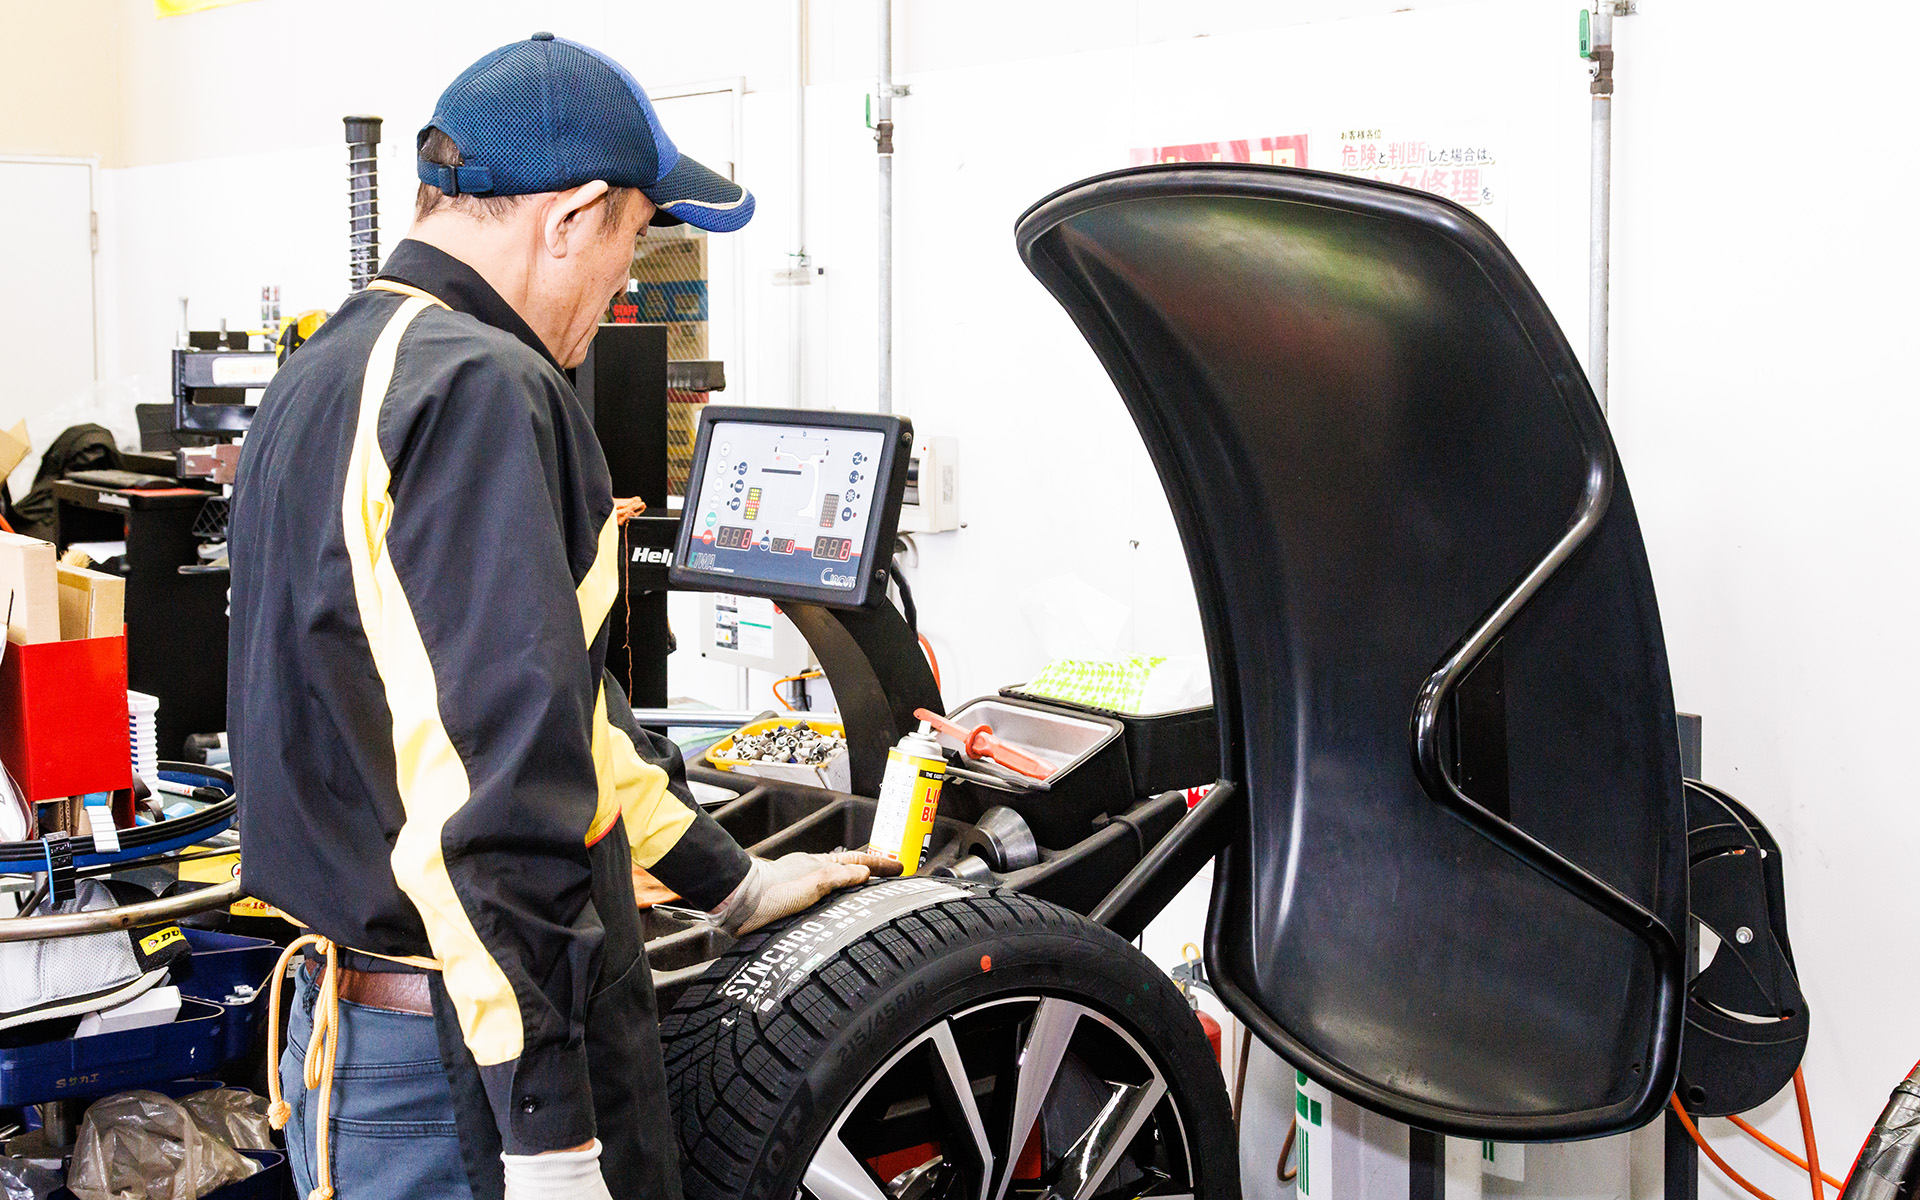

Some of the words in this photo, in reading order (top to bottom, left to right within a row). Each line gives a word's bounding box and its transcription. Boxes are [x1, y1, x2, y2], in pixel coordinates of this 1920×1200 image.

[1341, 129, 1382, 140] お客様各位
[1342, 141, 1494, 167] 危険と判断した場合は、
[613, 304, 639, 316] STAFF
[161, 930, 183, 942] DU
[814, 930, 834, 942] 18
[725, 921, 824, 1000] SYNCHRO
